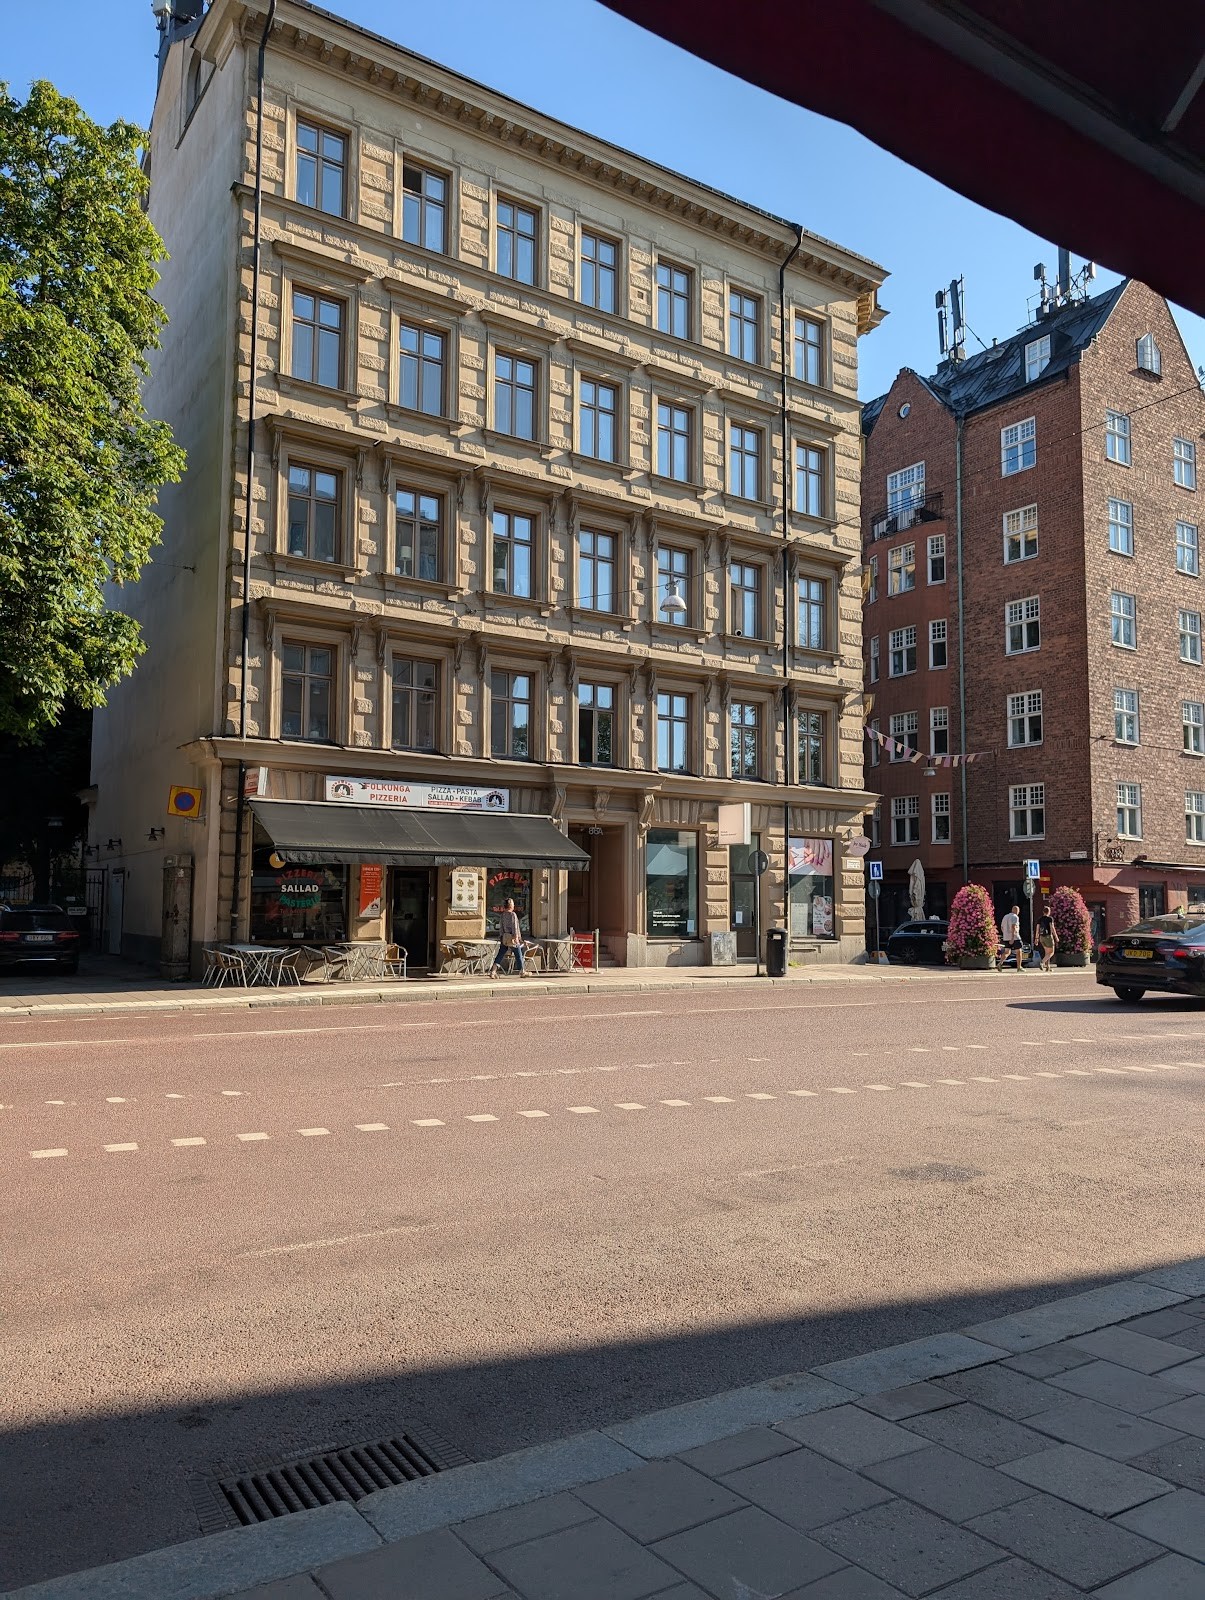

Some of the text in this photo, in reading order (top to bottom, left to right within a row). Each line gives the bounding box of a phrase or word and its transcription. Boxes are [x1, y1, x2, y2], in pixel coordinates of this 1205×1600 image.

[364, 782, 411, 792] FOLKUNGA
[431, 786, 451, 794] PIZZA
[369, 793, 408, 802] PIZZERIA
[427, 793, 454, 802] SALLAD
[459, 795, 482, 803] KEBAB
[281, 884, 319, 893] SALLAD
